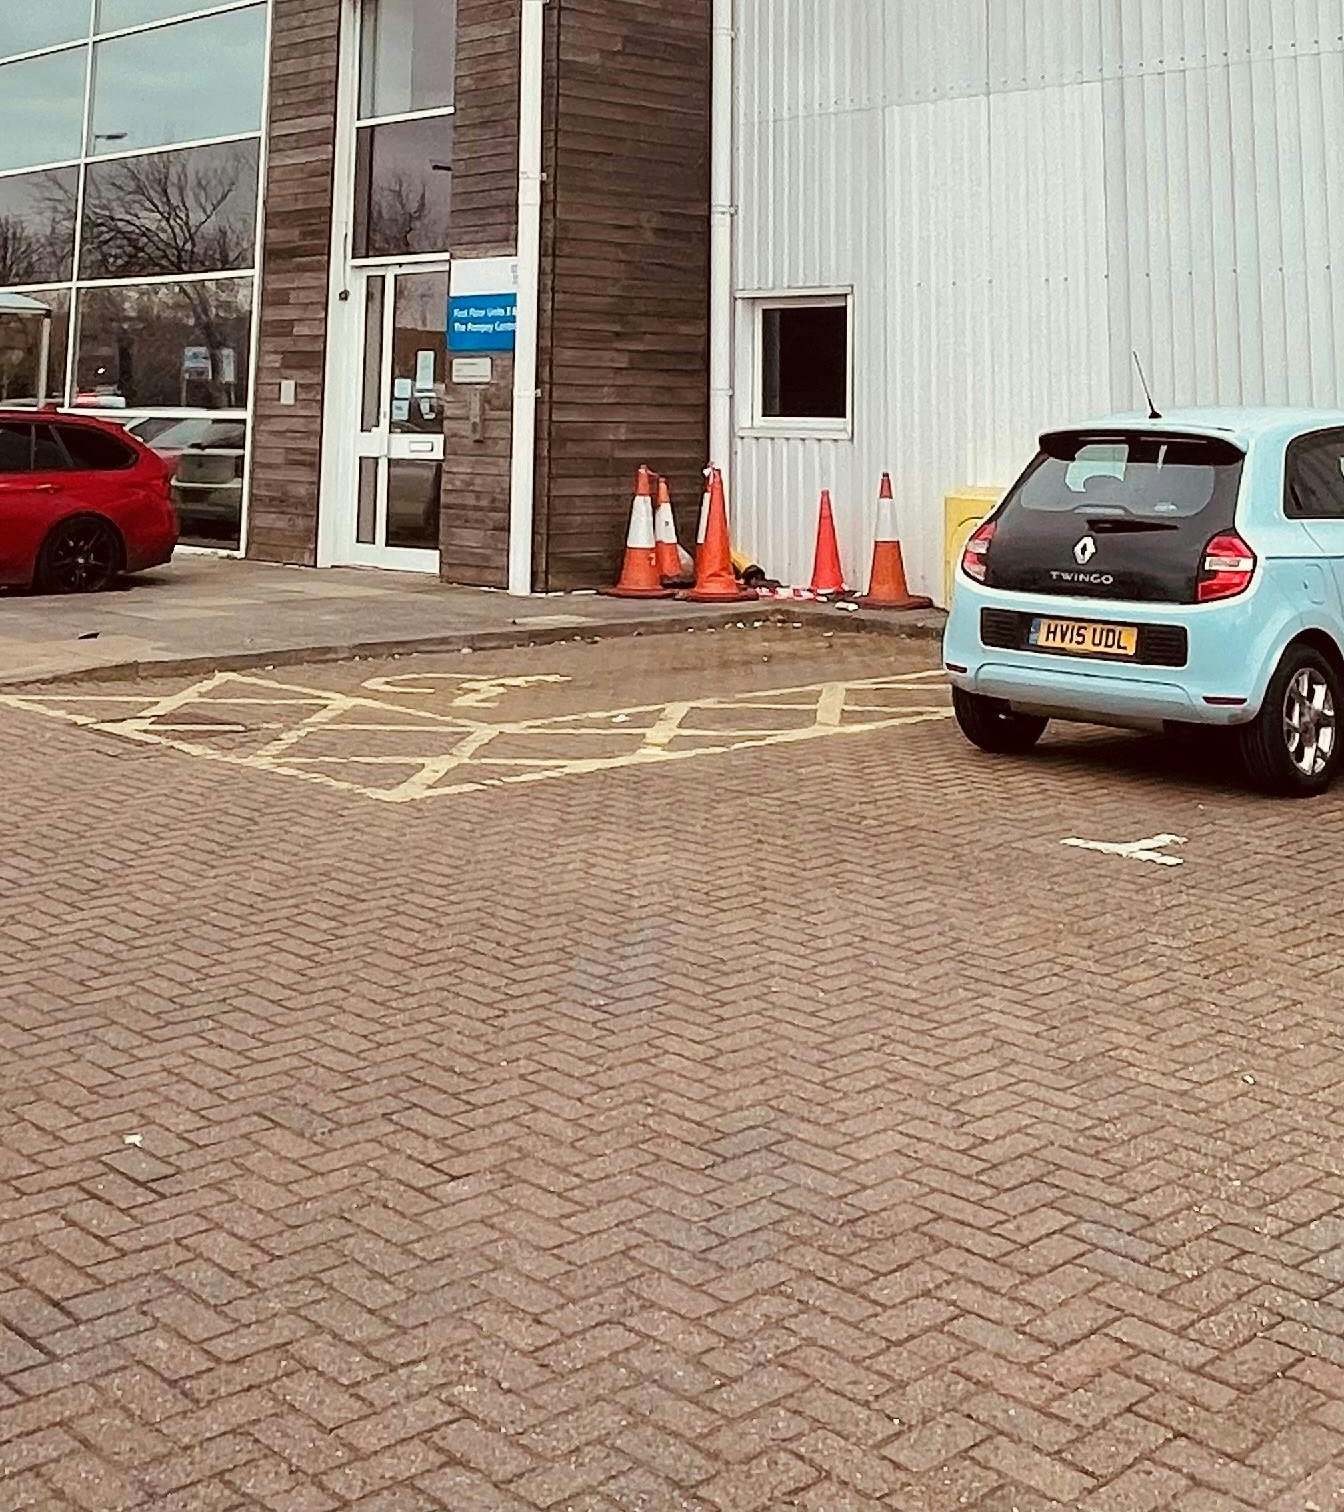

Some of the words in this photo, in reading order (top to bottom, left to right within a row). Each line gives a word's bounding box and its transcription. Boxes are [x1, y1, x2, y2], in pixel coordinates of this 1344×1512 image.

[1049, 570, 1114, 585] TWINGO
[1045, 622, 1088, 646] HV15
[1091, 626, 1128, 651] UDL
